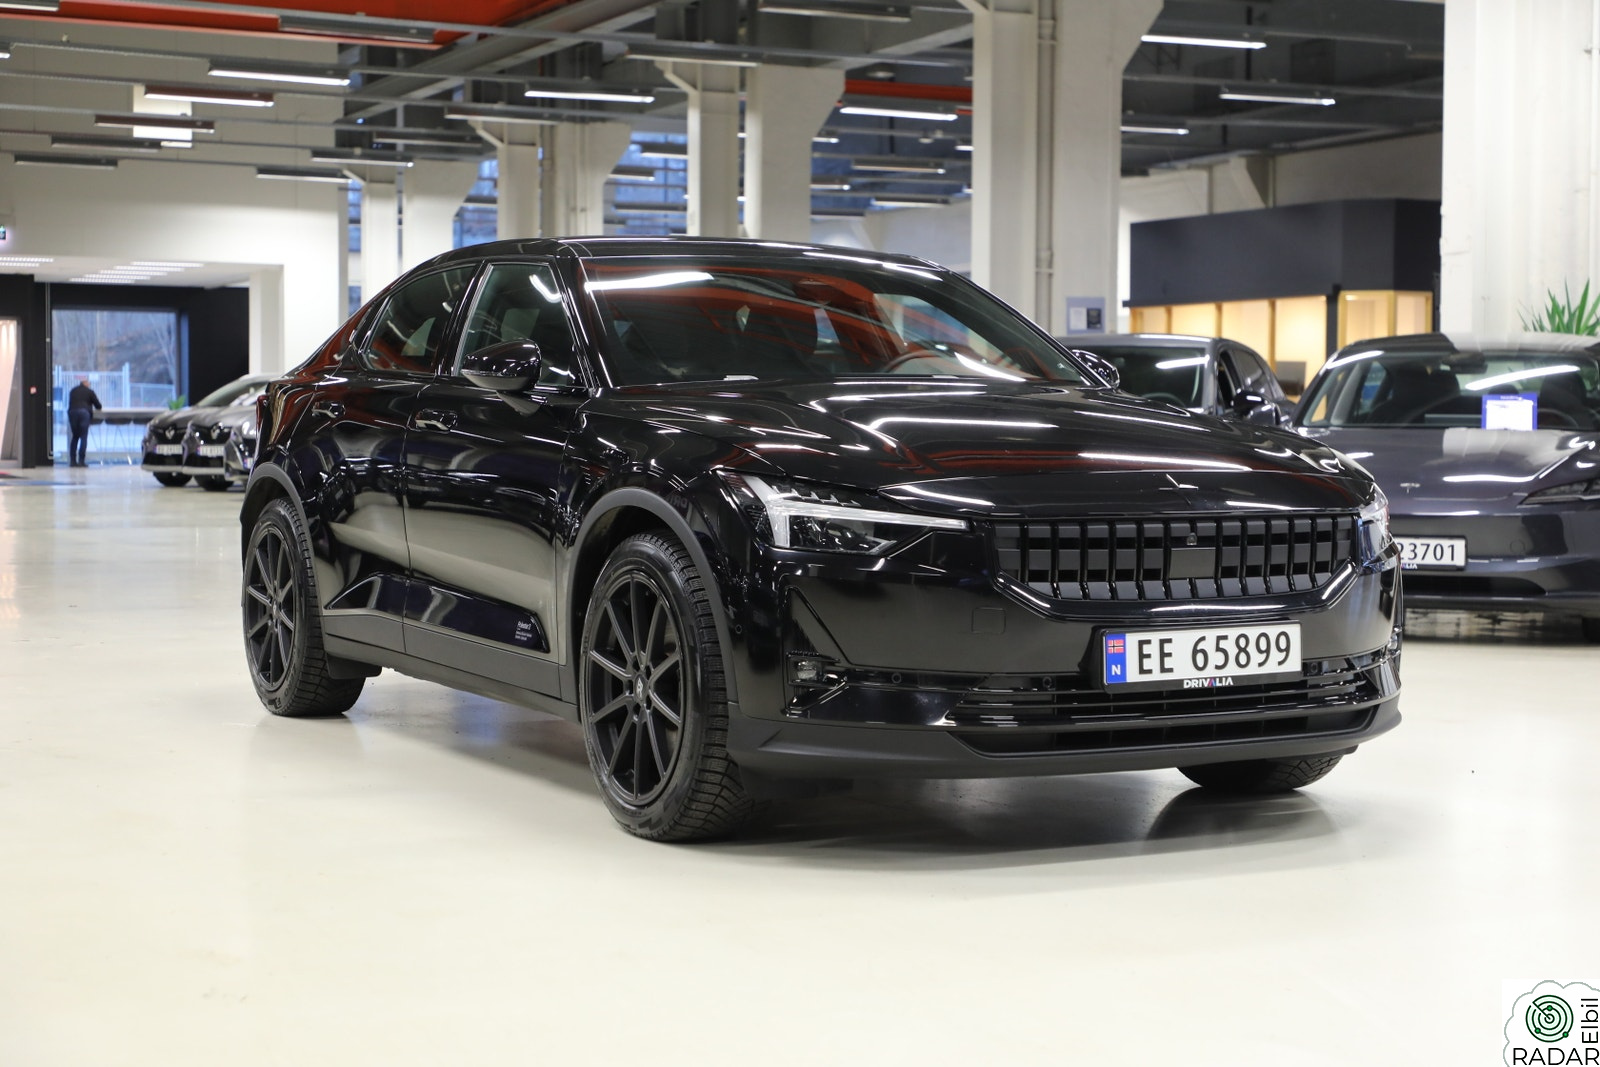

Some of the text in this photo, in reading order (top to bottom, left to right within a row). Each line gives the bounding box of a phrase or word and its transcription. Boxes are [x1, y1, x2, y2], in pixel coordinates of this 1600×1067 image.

[1137, 630, 1291, 675] EE 65899
[1111, 664, 1122, 676] N
[1183, 676, 1234, 689] DRIVALIA
